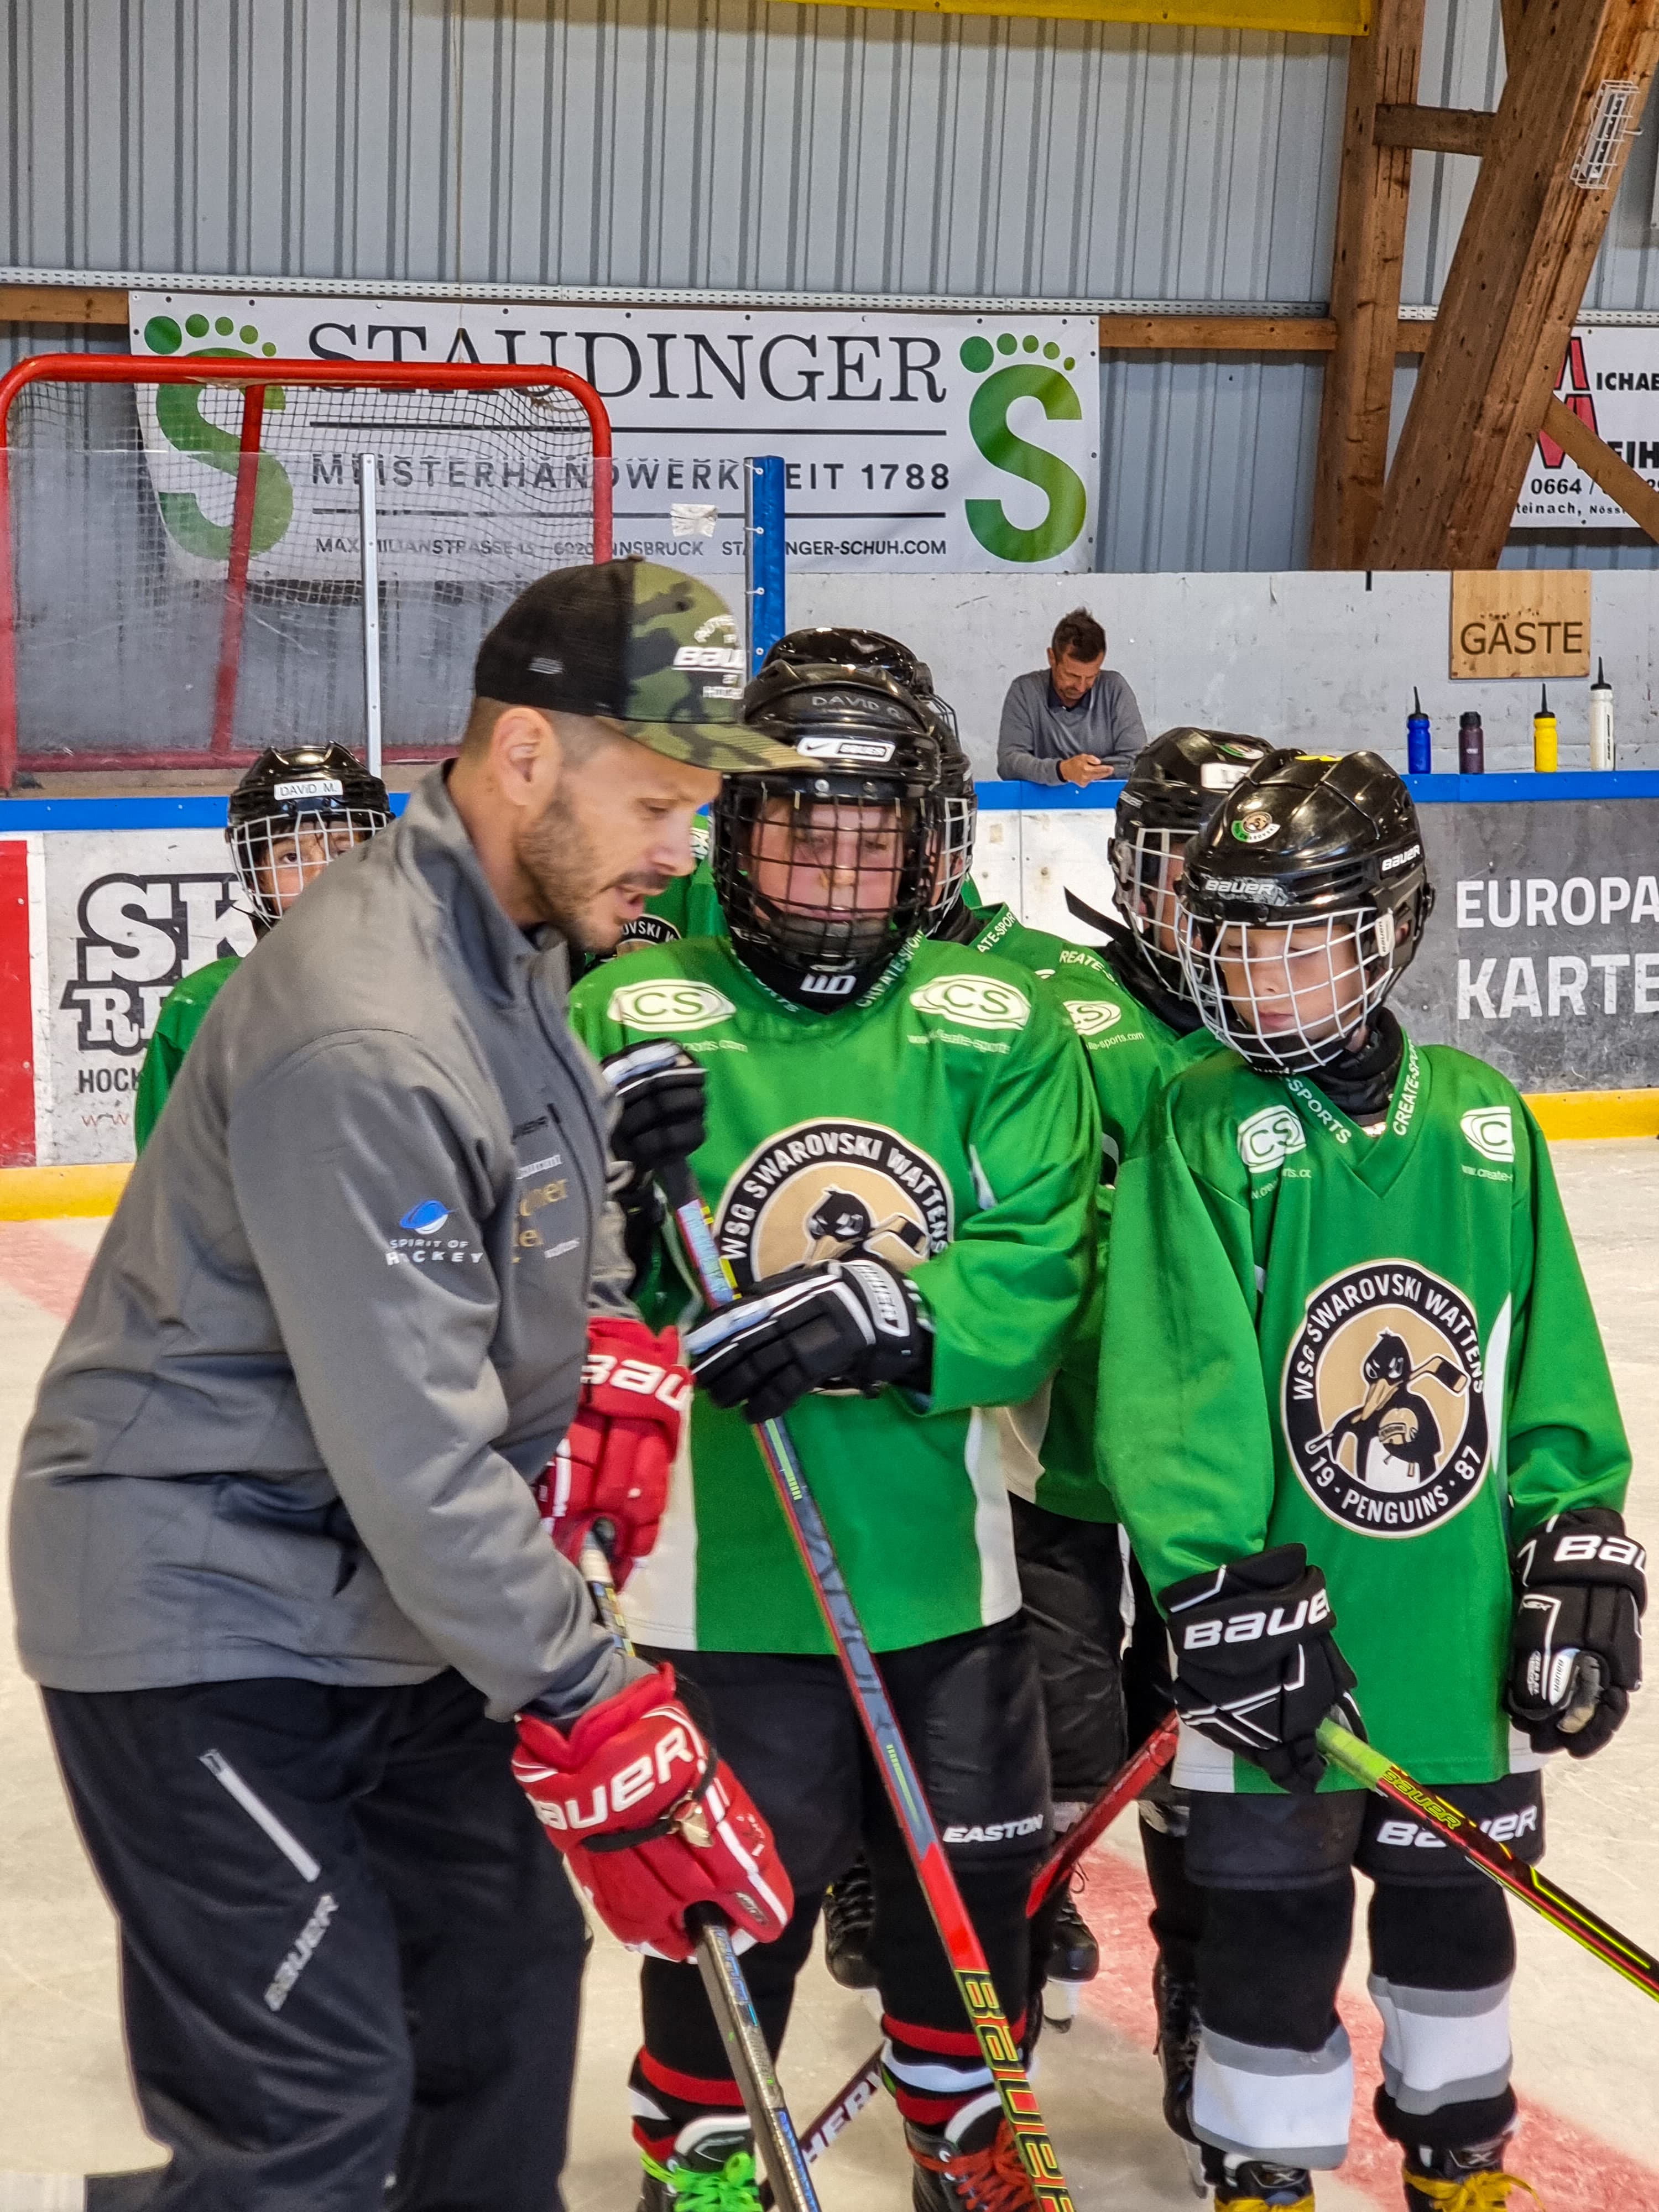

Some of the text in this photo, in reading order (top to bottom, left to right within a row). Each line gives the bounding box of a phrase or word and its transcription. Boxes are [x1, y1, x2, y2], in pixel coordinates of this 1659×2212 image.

[309, 322, 947, 404] STAUDINGER
[312, 453, 950, 491] MISTERHANWERK EIT 1788
[1531, 478, 1582, 495] 0664
[1516, 502, 1582, 517] teinach,
[1460, 614, 1583, 655] GÄSTE
[811, 695, 879, 710] DAVID
[279, 782, 316, 796] DAVID
[1382, 844, 1421, 872] BAUER
[1205, 879, 1275, 895] BAUER
[1456, 875, 1659, 928] EUROPA
[944, 984, 1009, 1014] CS
[1457, 952, 1659, 1020] KARTE
[634, 992, 704, 1016] CS
[721, 1131, 949, 1261] WSG SWAROVSKI WATTENS
[389, 1239, 469, 1249] SPIRIT OF
[1293, 1272, 1485, 1401] WSG SWAROVSKI WATTENS
[1309, 1445, 1482, 1524] 19 PENGUINS 87
[942, 1814, 1044, 1843] EASTON
[1376, 1804, 1538, 1848] BAER
